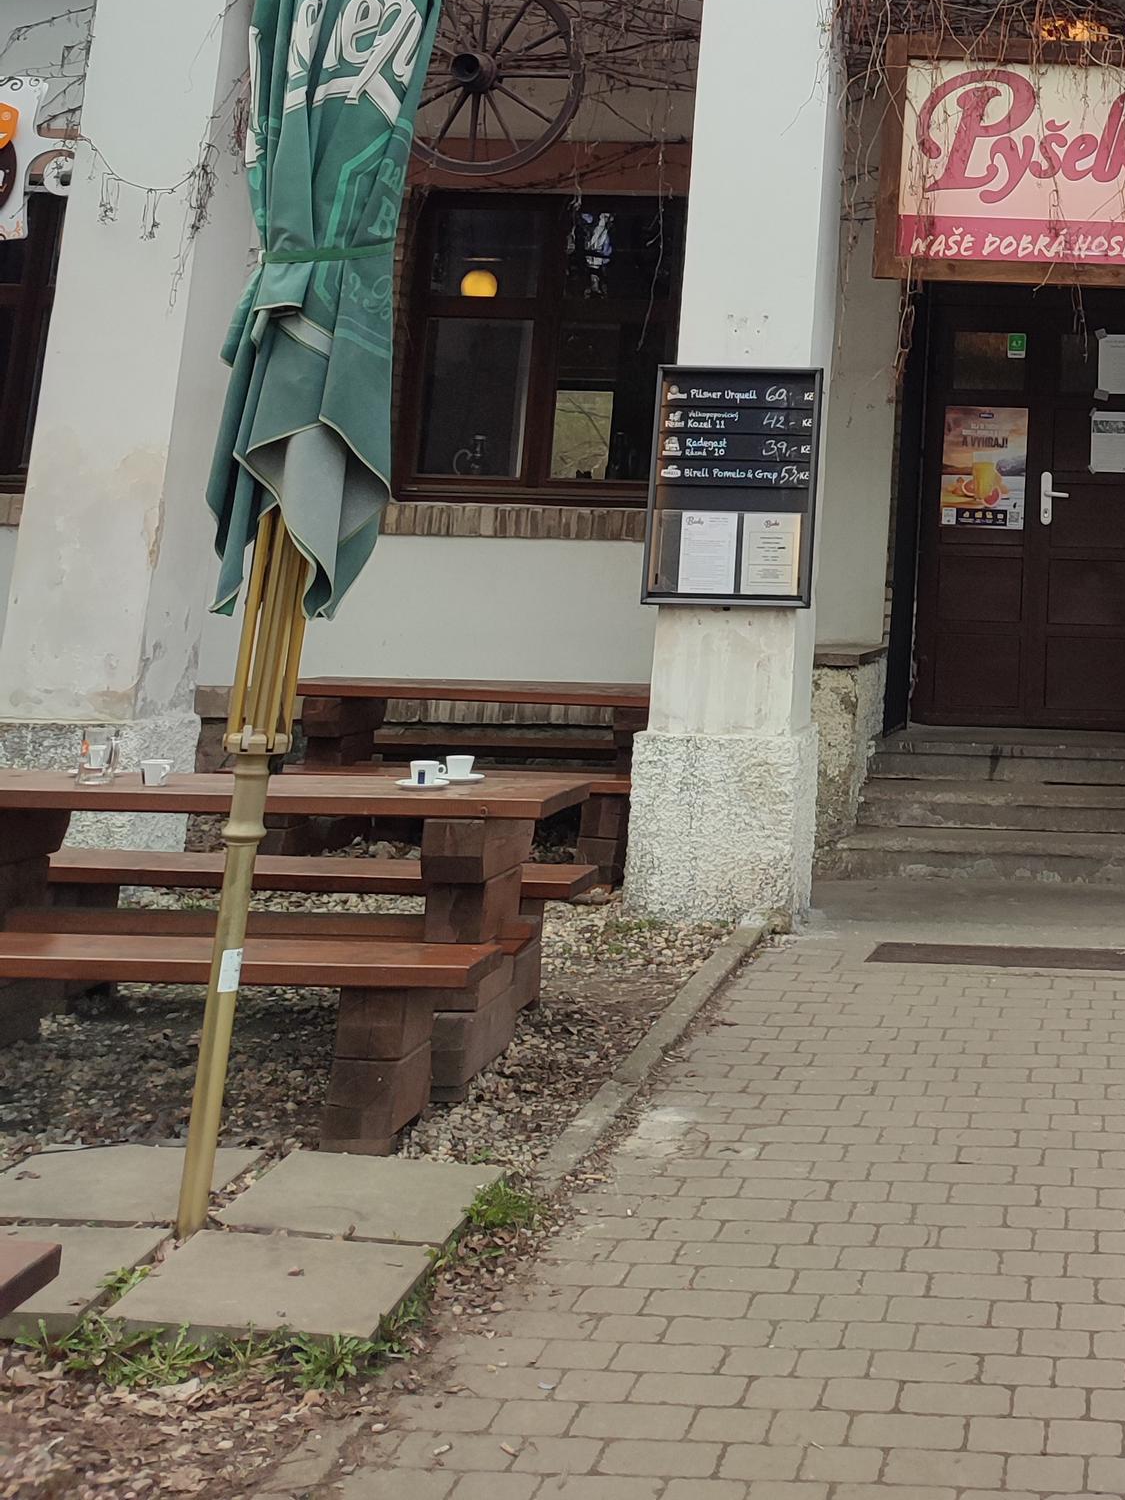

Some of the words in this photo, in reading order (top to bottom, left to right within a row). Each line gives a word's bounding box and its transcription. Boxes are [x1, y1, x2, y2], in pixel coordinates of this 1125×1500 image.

[911, 227, 974, 257] NAŠE
[982, 228, 1068, 258] DOBRÁ
[690, 388, 722, 400] Pilsner
[724, 389, 758, 404] Urquell
[804, 392, 814, 401] Kč
[687, 420, 712, 429] Kozel
[715, 420, 725, 429] 11
[801, 419, 812, 428] Kč
[686, 437, 727, 451] Radegast
[801, 445, 811, 454] Kč
[684, 468, 709, 478] Birell
[713, 468, 746, 479] Pomelo
[754, 471, 778, 484] Grep
[799, 471, 810, 480] Kč
